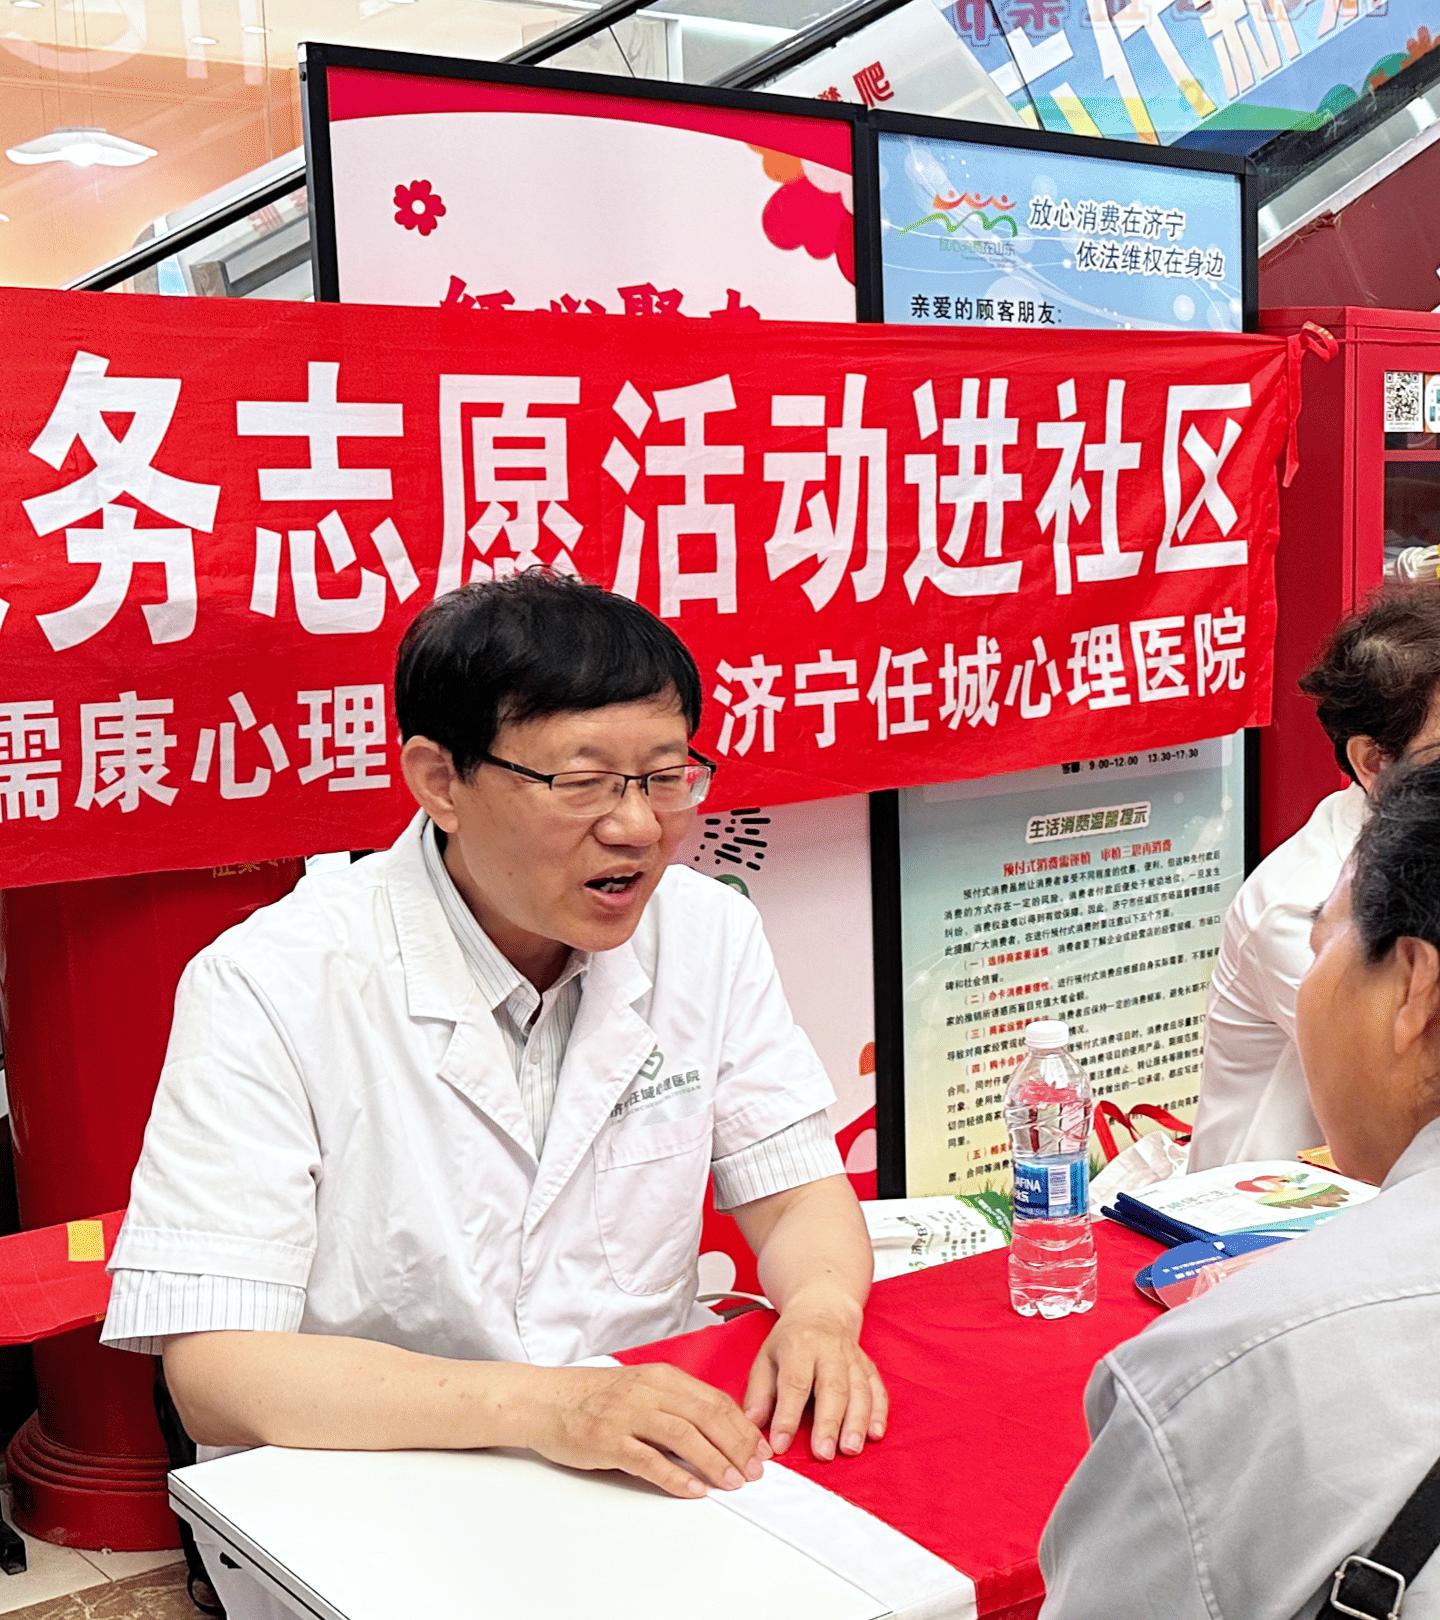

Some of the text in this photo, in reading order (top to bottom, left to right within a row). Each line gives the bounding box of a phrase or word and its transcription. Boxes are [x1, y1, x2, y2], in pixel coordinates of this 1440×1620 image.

[1030, 198, 1185, 239] 放心消费在济宁
[1075, 240, 1225, 279] 依法维权在身边
[0, 350, 1252, 653] 务志愿活动进社区
[712, 606, 1248, 758] 济宁任城心理医院
[1028, 804, 1149, 840] 生活消费温馨提示
